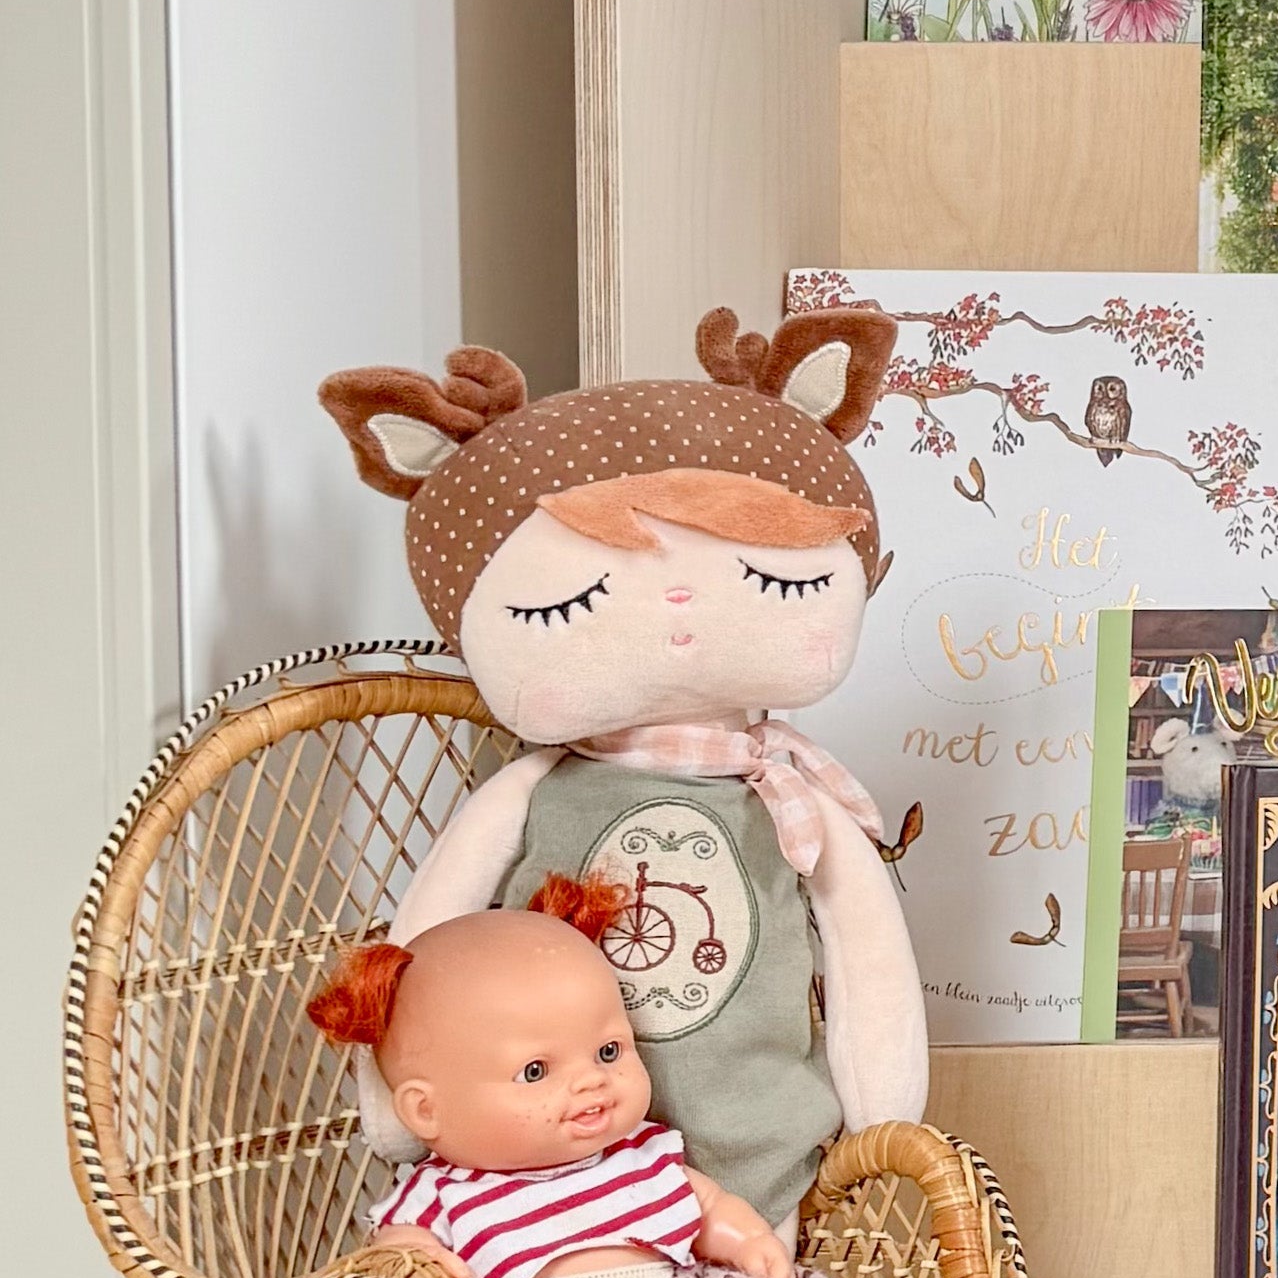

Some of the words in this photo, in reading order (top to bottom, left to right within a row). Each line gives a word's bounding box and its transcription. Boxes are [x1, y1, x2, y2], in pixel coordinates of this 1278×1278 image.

[1019, 507, 1120, 570] Het
[902, 722, 999, 767] met
[1015, 729, 1094, 766] een
[945, 982, 980, 1003] klein
[986, 990, 1030, 1013] zaadje
